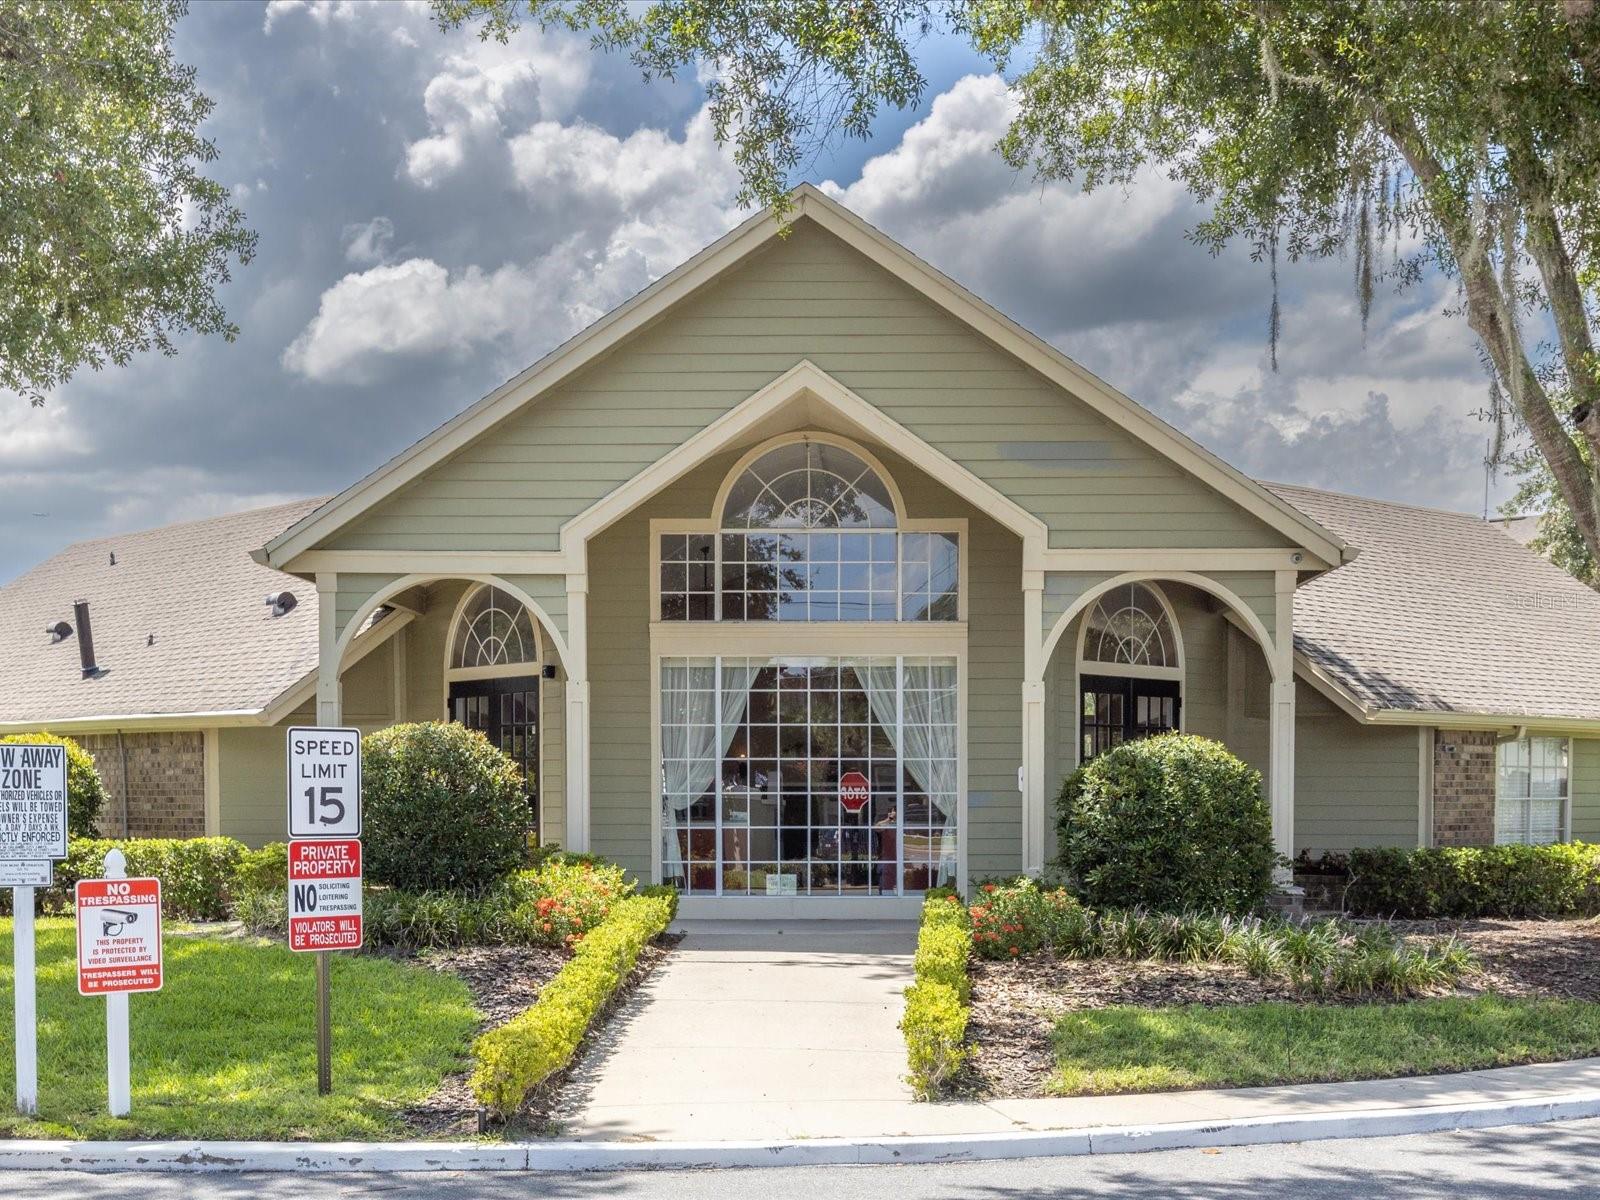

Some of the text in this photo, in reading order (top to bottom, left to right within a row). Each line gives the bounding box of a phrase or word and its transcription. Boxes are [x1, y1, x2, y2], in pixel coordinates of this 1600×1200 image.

[295, 740, 354, 755] SPEED
[21, 748, 61, 768] AWAY
[302, 764, 347, 778] LIMIT
[2, 769, 41, 789] ZONE
[26, 790, 53, 801] VEHICLES
[54, 790, 62, 800] OR
[12, 802, 27, 812] WILL
[30, 802, 37, 812] BE
[40, 802, 62, 812] TOWED
[304, 787, 345, 824] 15
[29, 813, 58, 823] EXPENSE
[22, 832, 60, 842] ENFORCED
[301, 845, 349, 860] PRIVATE
[293, 860, 356, 875] PROPERTY
[107, 883, 130, 895] NO
[80, 895, 157, 905] TRESPASSING
[294, 884, 317, 912] NO
[295, 920, 357, 934] VIOLATORS WILL
[295, 932, 357, 946] BE PROSECUTED
[109, 955, 152, 964] SURVEILLANCE
[82, 969, 137, 979] TRESPASSERS
[103, 978, 154, 987] PROSECUTED
